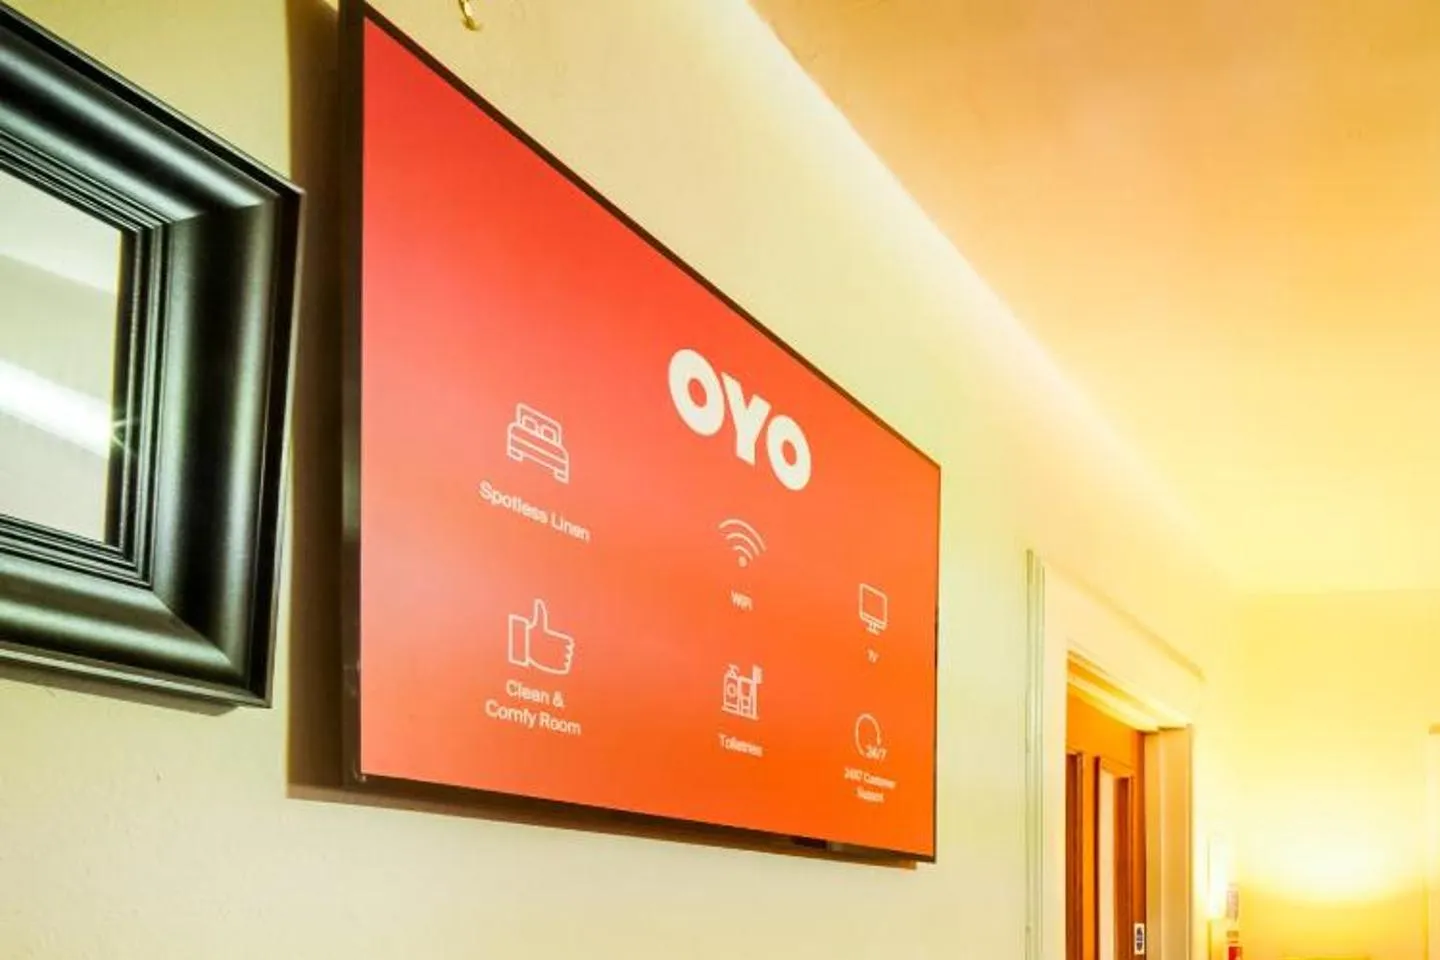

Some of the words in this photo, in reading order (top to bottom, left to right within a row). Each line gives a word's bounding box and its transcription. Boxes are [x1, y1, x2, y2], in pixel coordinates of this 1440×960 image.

[668, 348, 811, 490] OYO
[479, 479, 549, 524] Spotless
[551, 511, 590, 543] Linen
[485, 699, 537, 729] Comfy
[539, 711, 582, 735] Room
[506, 679, 551, 705] Clean
[552, 691, 566, 709] &
